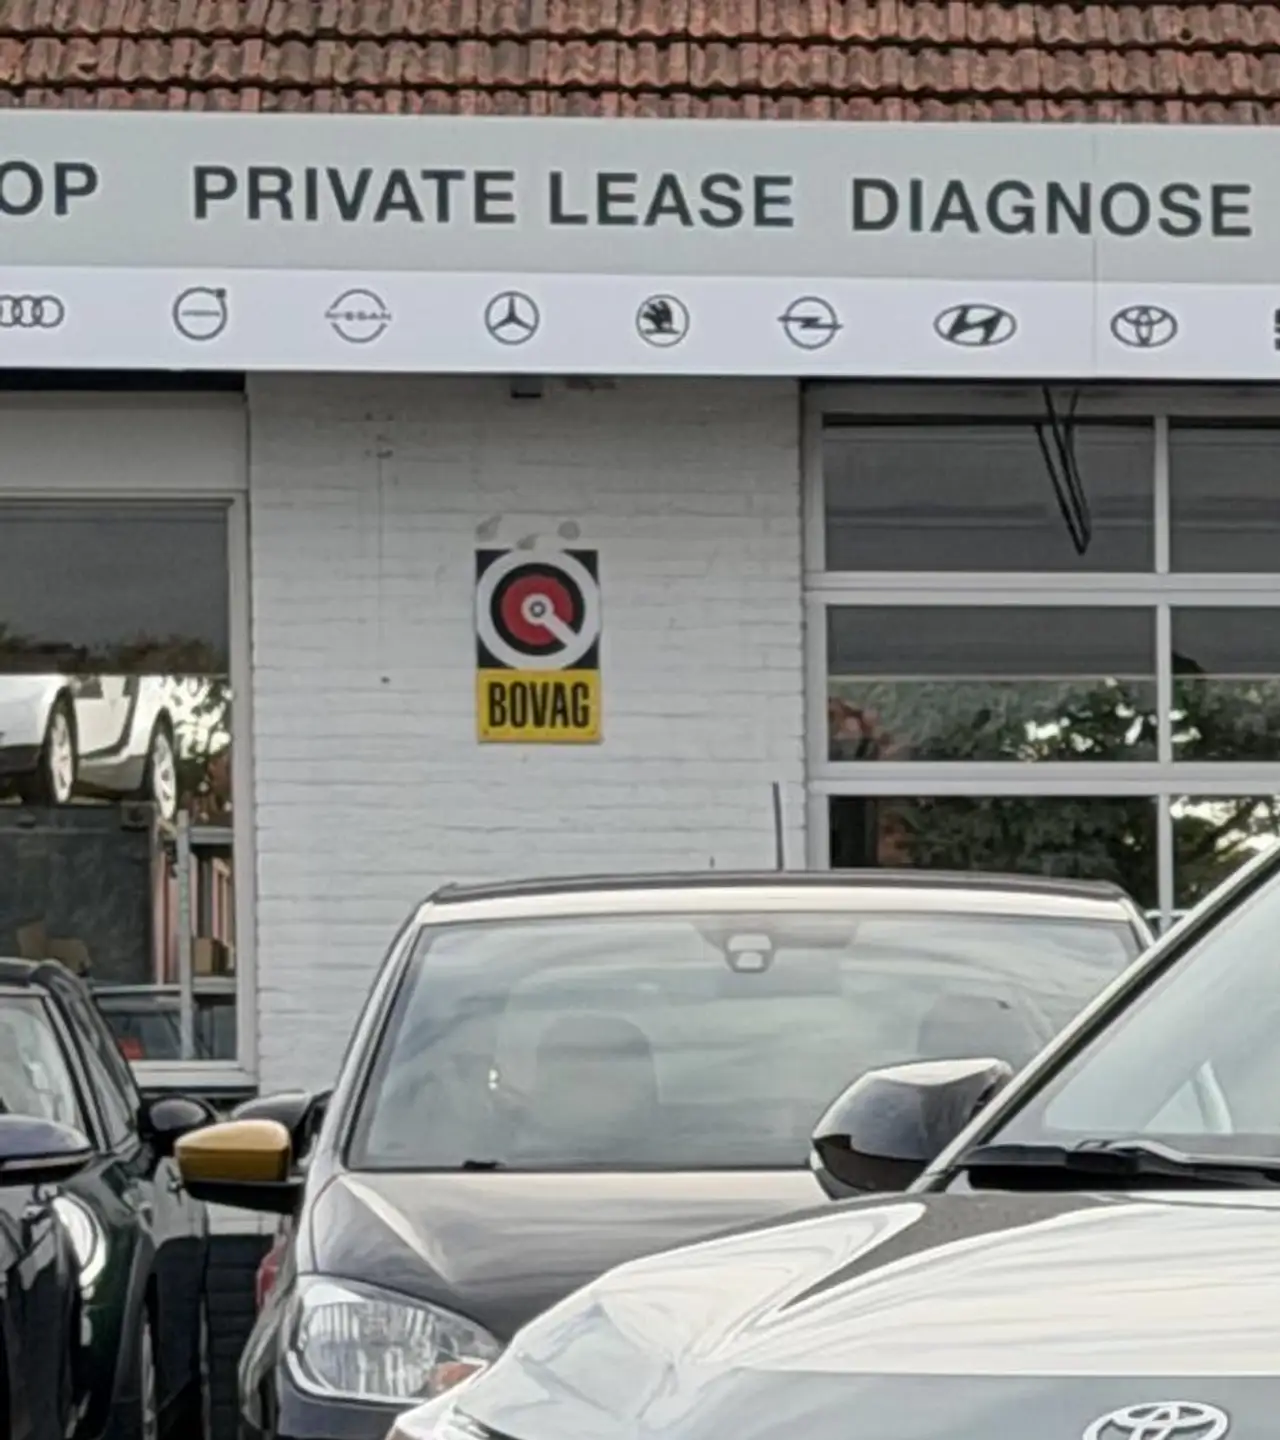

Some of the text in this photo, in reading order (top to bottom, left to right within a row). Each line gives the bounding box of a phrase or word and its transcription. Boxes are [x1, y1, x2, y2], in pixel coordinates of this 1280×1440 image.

[0, 161, 98, 216] OP
[194, 165, 795, 229] PRIVATE LEASE
[852, 177, 1253, 238] DIAGNOSE
[487, 681, 591, 729] BOVAG
